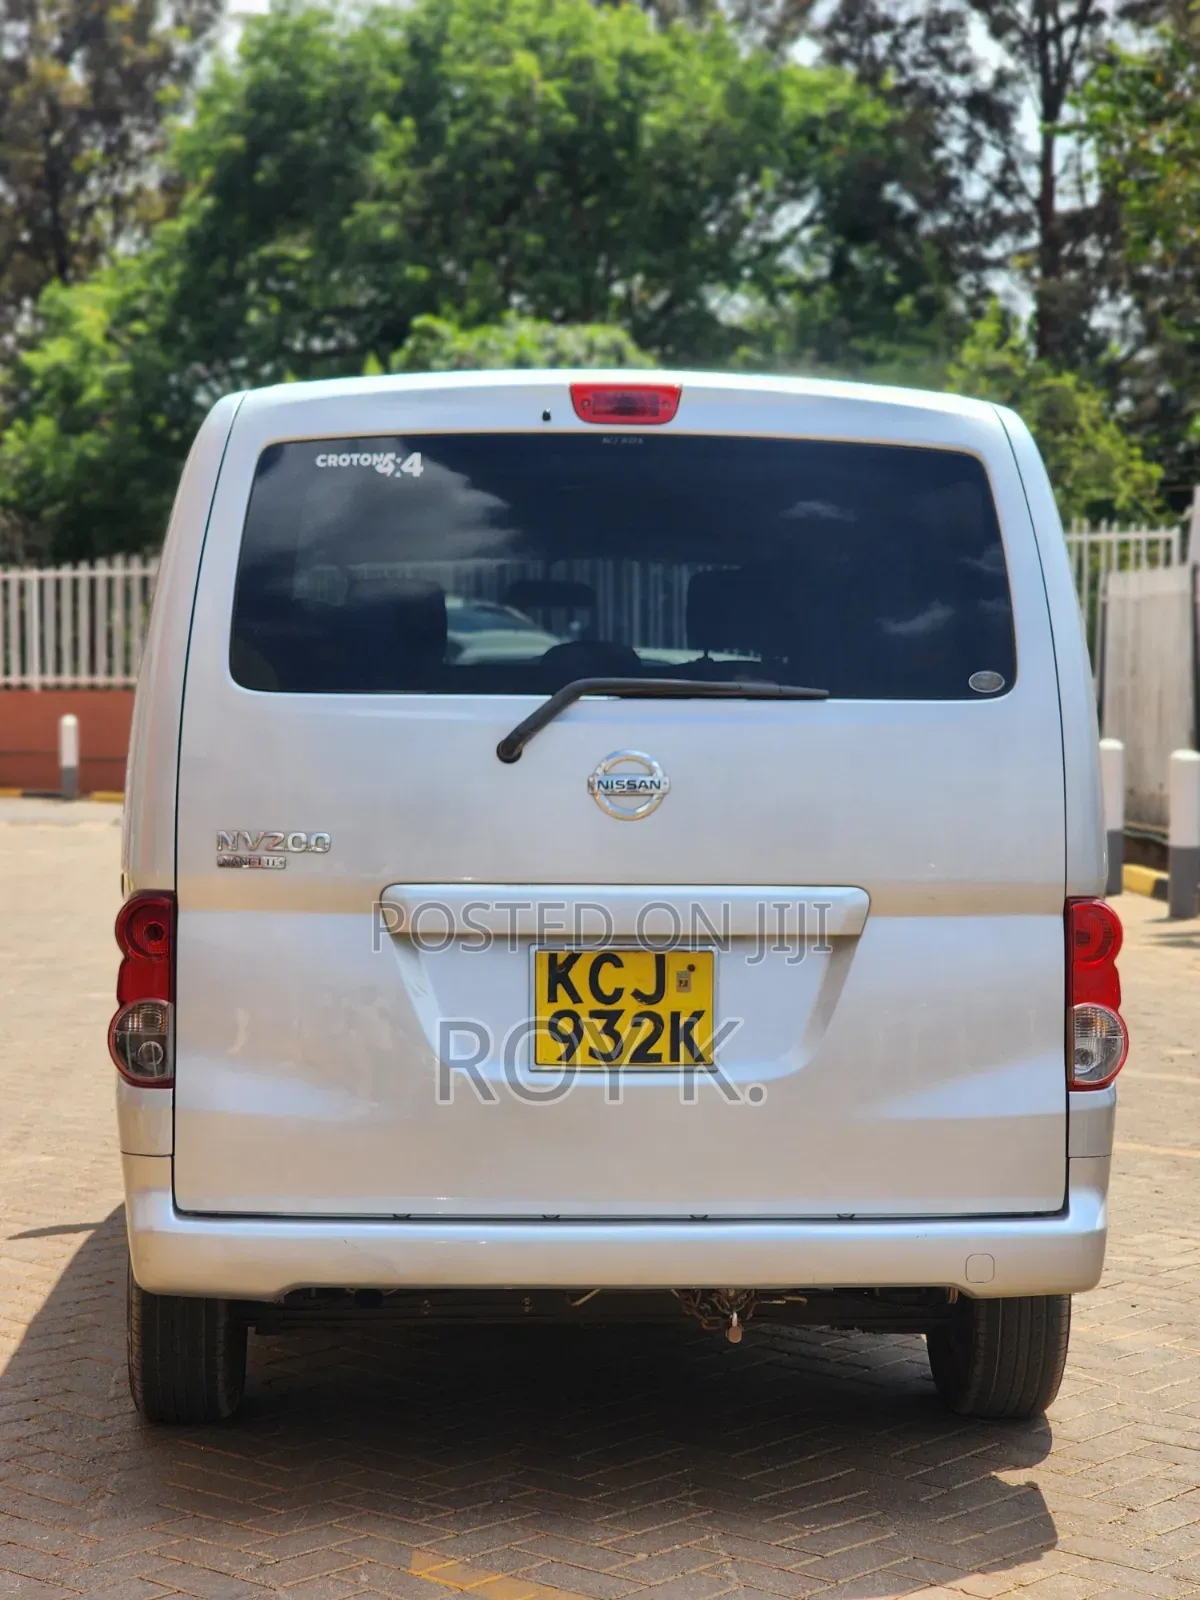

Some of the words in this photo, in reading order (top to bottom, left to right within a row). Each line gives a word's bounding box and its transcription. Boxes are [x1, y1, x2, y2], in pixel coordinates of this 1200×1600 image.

[596, 779, 662, 790] NISSAN
[217, 830, 332, 853] NV200
[547, 953, 666, 1005] KCJ
[548, 1009, 706, 1063] 932K
